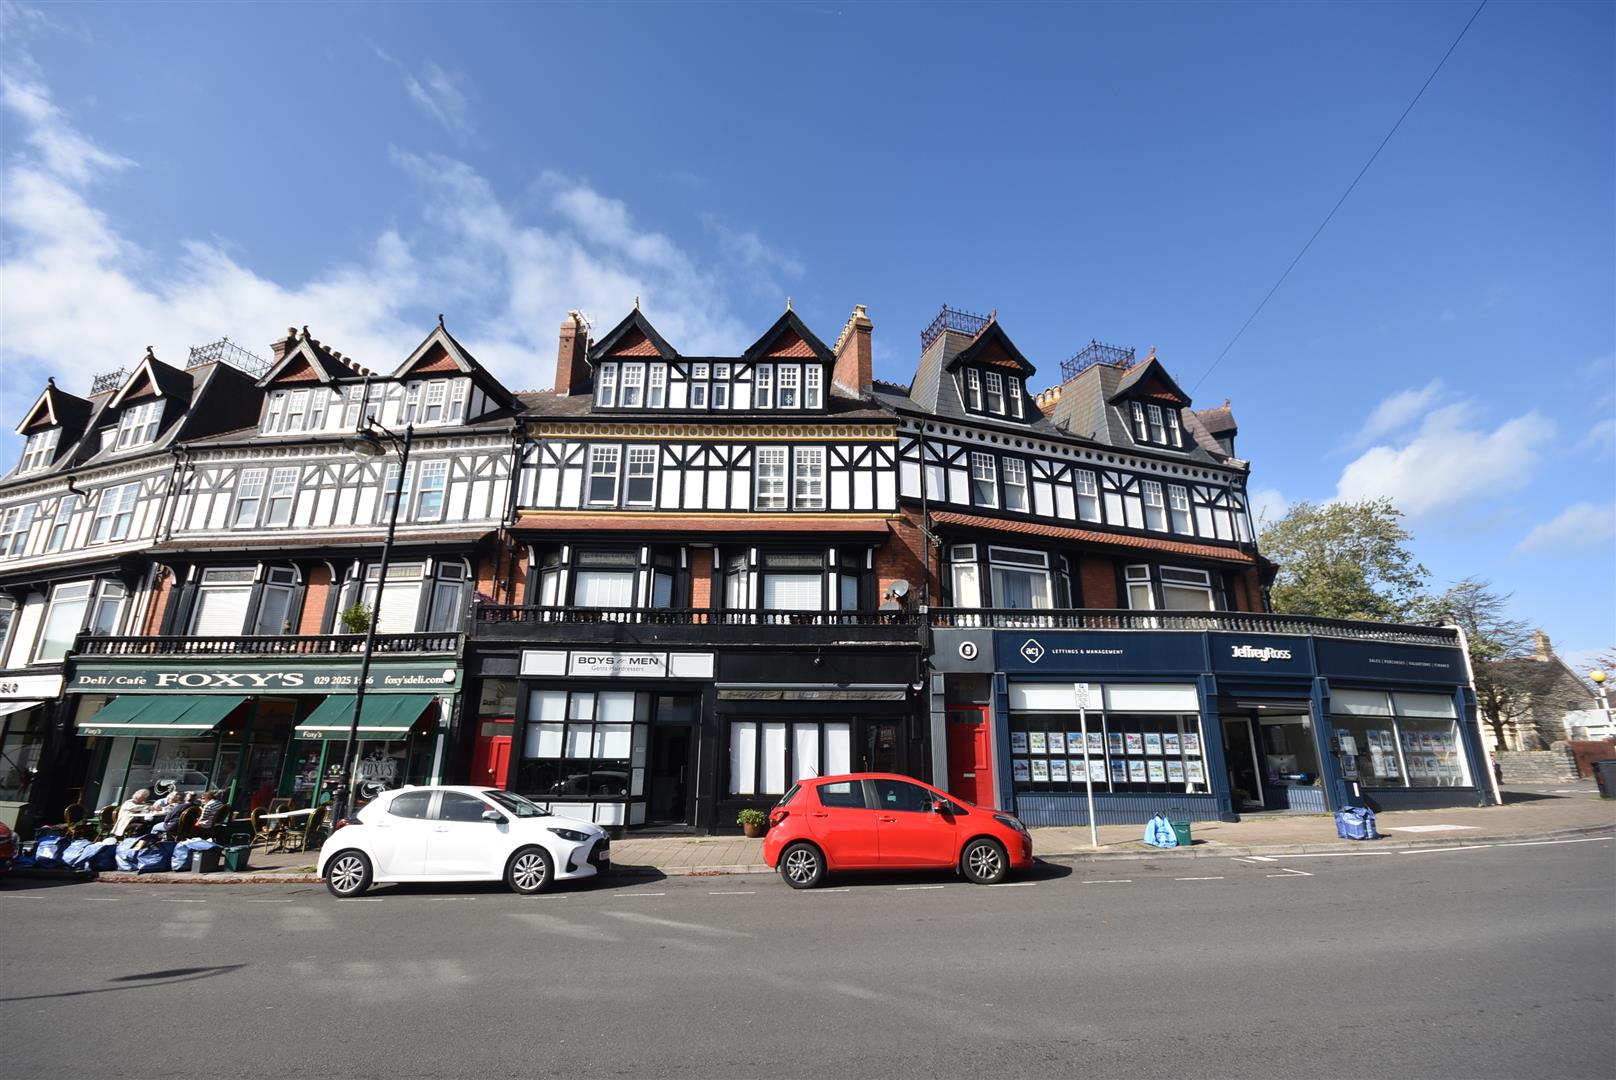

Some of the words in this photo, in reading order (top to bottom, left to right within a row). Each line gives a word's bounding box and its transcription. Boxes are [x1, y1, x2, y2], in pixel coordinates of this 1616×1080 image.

[578, 657, 615, 665] BOYS
[629, 658, 659, 666] MEN
[79, 675, 107, 685] Deli
[115, 675, 147, 685] Cafe
[155, 672, 304, 687] FOXY'S
[313, 676, 330, 685] 029
[330, 676, 352, 685] 2025
[302, 730, 323, 740] Foxy's
